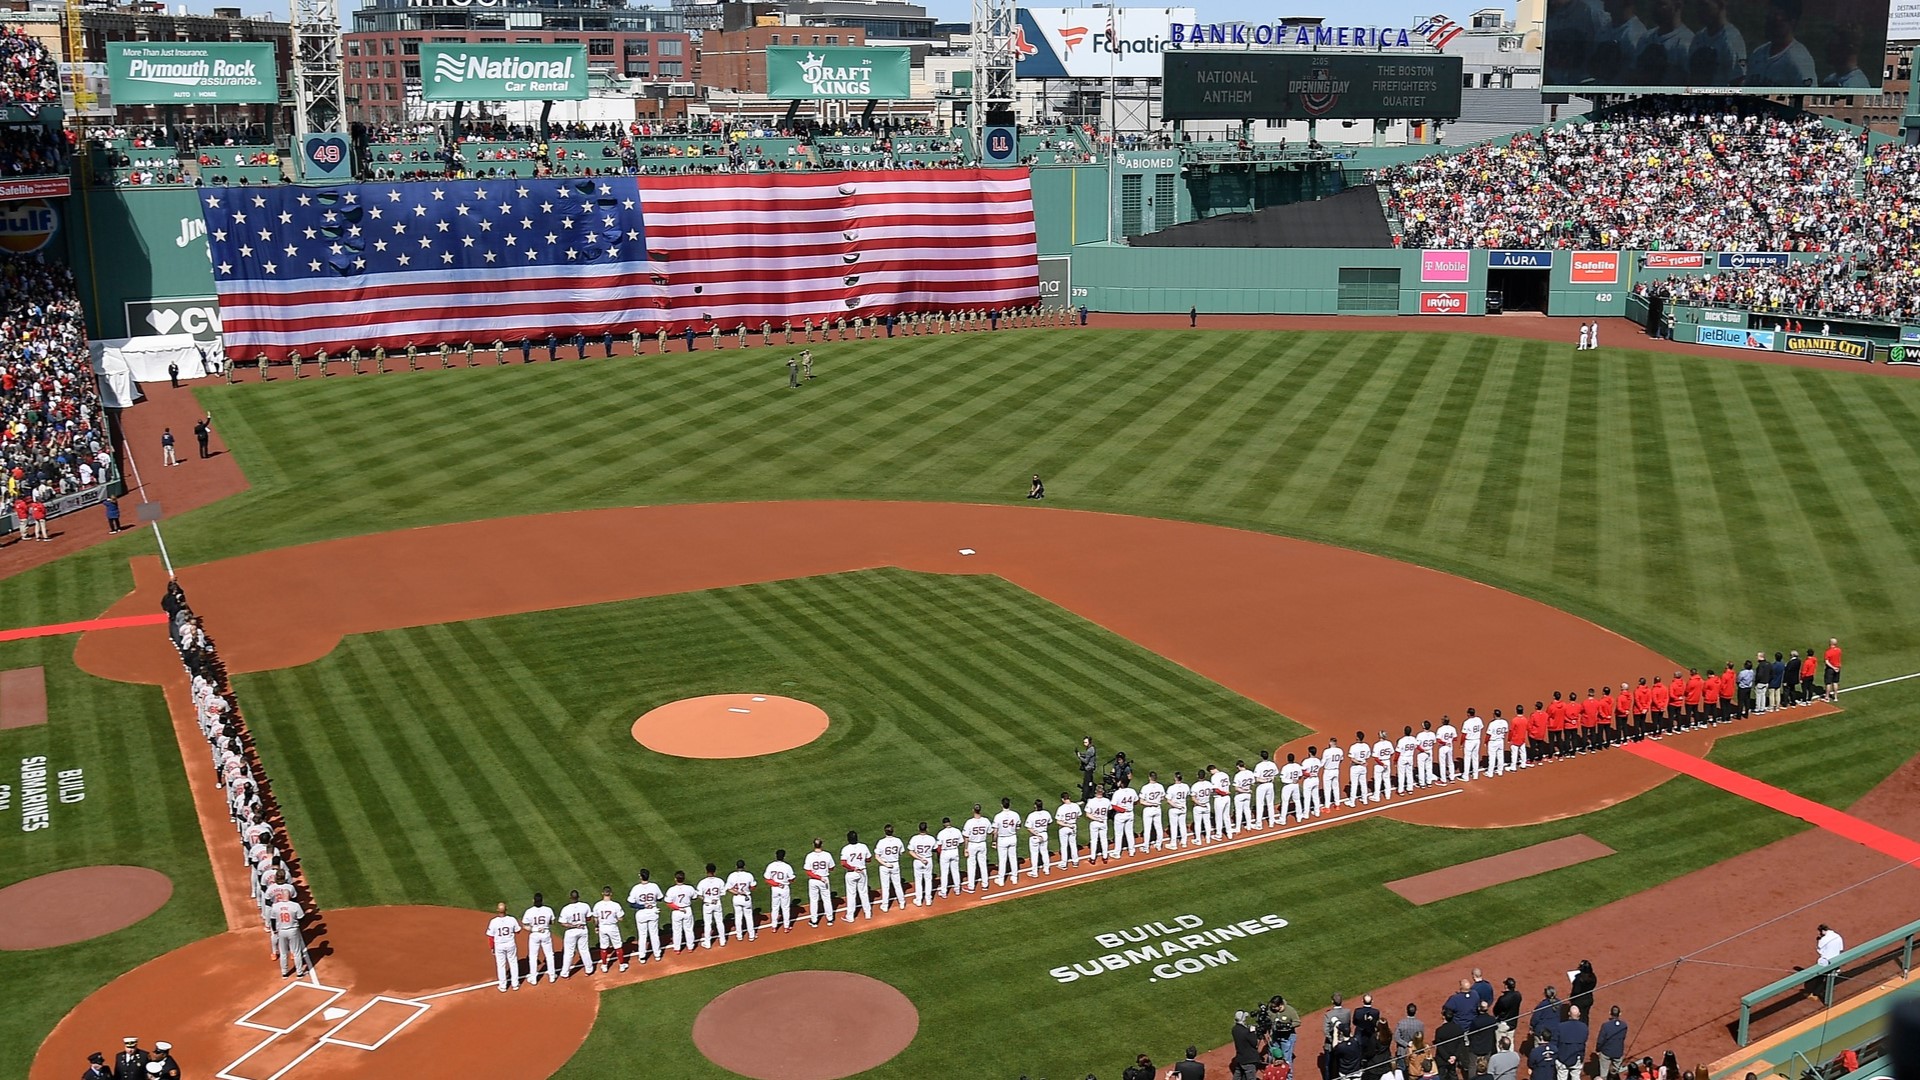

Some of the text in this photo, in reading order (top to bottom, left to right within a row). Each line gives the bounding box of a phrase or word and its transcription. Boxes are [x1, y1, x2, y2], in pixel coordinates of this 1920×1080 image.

[1171, 23, 1410, 47] BANK OF AMERICA
[122, 48, 142, 57] More
[142, 48, 160, 57] Than
[160, 48, 175, 57] Just
[1312, 57, 1329, 66] 2:05
[129, 59, 256, 79] Plymouth Rock
[1378, 65, 1435, 77] THE BOSTON
[802, 66, 872, 83] DRAFT
[1197, 70, 1258, 84] NATIONAL
[200, 77, 257, 86] assurance
[505, 80, 568, 92] Car Rental
[812, 80, 871, 95] KINGS
[1288, 80, 1351, 94] OPENING DAY
[1202, 90, 1252, 103] ANTHEM
[1383, 95, 1426, 107] QUARTET
[992, 136, 1009, 152] LL
[313, 145, 341, 164] 49
[1125, 157, 1174, 169] ABIOMED
[0, 184, 34, 196] Safelite
[0, 209, 52, 231] ulf
[1574, 261, 1615, 270] Safelite
[1649, 255, 1702, 266] ACE TICKET
[1425, 260, 1466, 272] T Mobile
[1071, 288, 1088, 297] 379
[1595, 293, 1613, 302] 420
[1427, 297, 1460, 308] IRVING
[1701, 328, 1740, 343] jetBlue
[1788, 337, 1865, 356] GRANITE CITY
[1331, 754, 1341, 762] 10
[1263, 769, 1274, 778] 22
[1309, 765, 1319, 773] 12
[57, 768, 85, 804] BUILD
[21, 755, 49, 832] SUBMARINES
[1148, 792, 1161, 801] 37
[1176, 791, 1186, 800] 31
[1198, 788, 1210, 798] 30
[1121, 796, 1133, 804] 44
[1094, 807, 1107, 816] 48
[1002, 819, 1015, 829] 54
[1034, 819, 1048, 828] 52
[972, 826, 986, 836] 55
[945, 838, 959, 848] 56
[884, 846, 898, 856] 63
[916, 845, 931, 854] 57
[849, 852, 863, 862] 74
[770, 871, 784, 881] 70
[705, 887, 719, 897] 43
[733, 882, 747, 893] 47
[639, 893, 654, 902] 36
[677, 894, 686, 904] 7
[280, 912, 291, 923] 18
[572, 912, 581, 922] 11
[600, 910, 612, 920] 17
[533, 916, 546, 925] 16
[497, 926, 510, 937] 13
[1094, 914, 1204, 949] BUILD
[1049, 914, 1289, 984] SUBMARINES
[1149, 949, 1240, 984] .COM
